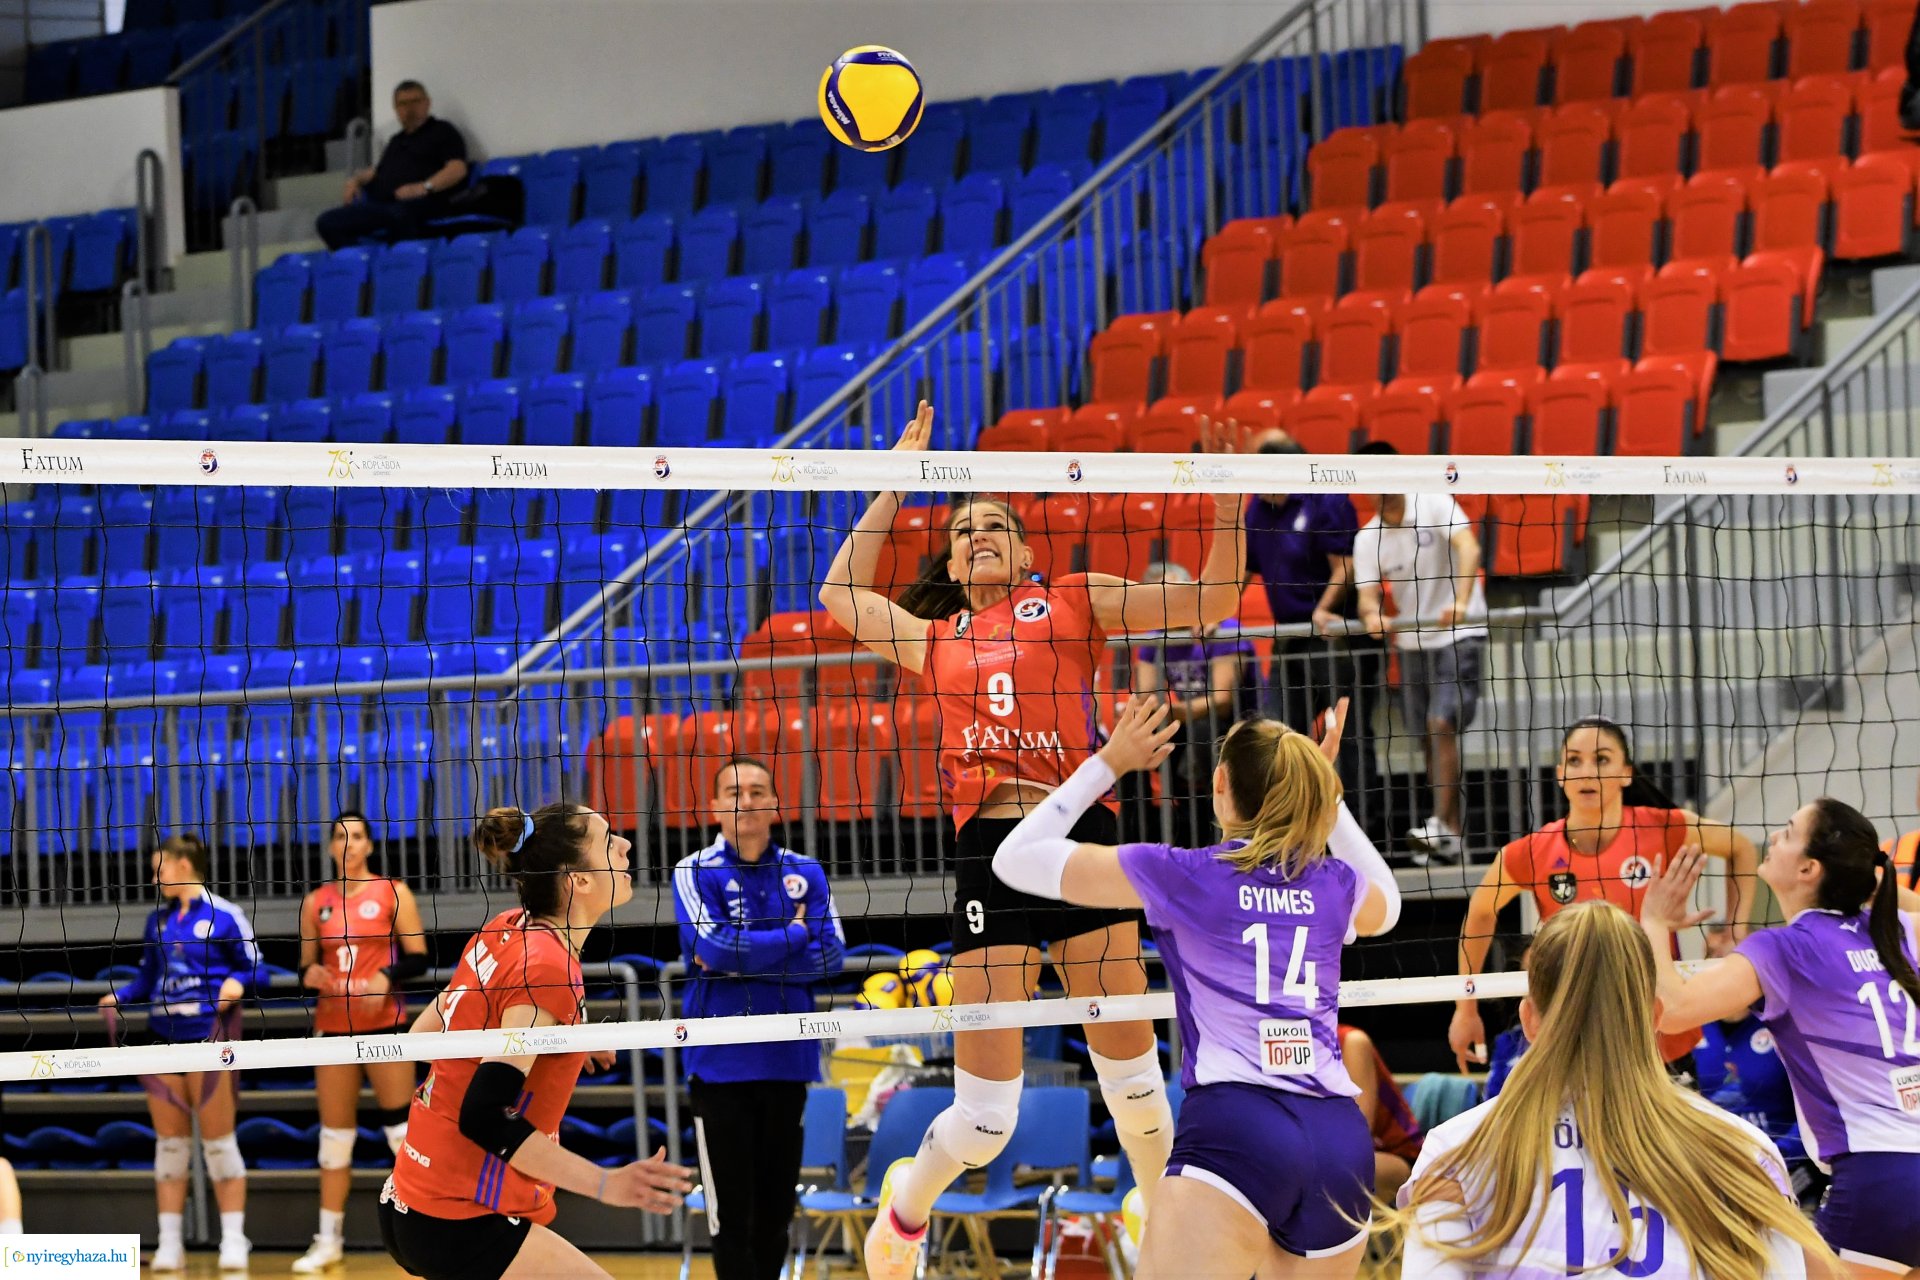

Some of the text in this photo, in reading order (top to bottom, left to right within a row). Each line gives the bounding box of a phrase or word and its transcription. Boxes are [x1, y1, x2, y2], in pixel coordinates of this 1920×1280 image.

[988, 672, 1014, 716] 9
[962, 720, 1065, 756] FATUM
[966, 899, 984, 934] 9
[1239, 885, 1315, 914] GYIMES
[1242, 922, 1319, 1009] 14
[1846, 948, 1886, 973] DUR
[1267, 1027, 1309, 1037] LUKOIL
[1857, 979, 1920, 1059] 12
[1897, 1073, 1920, 1086] LUKO
[1551, 1167, 1664, 1277] 15
